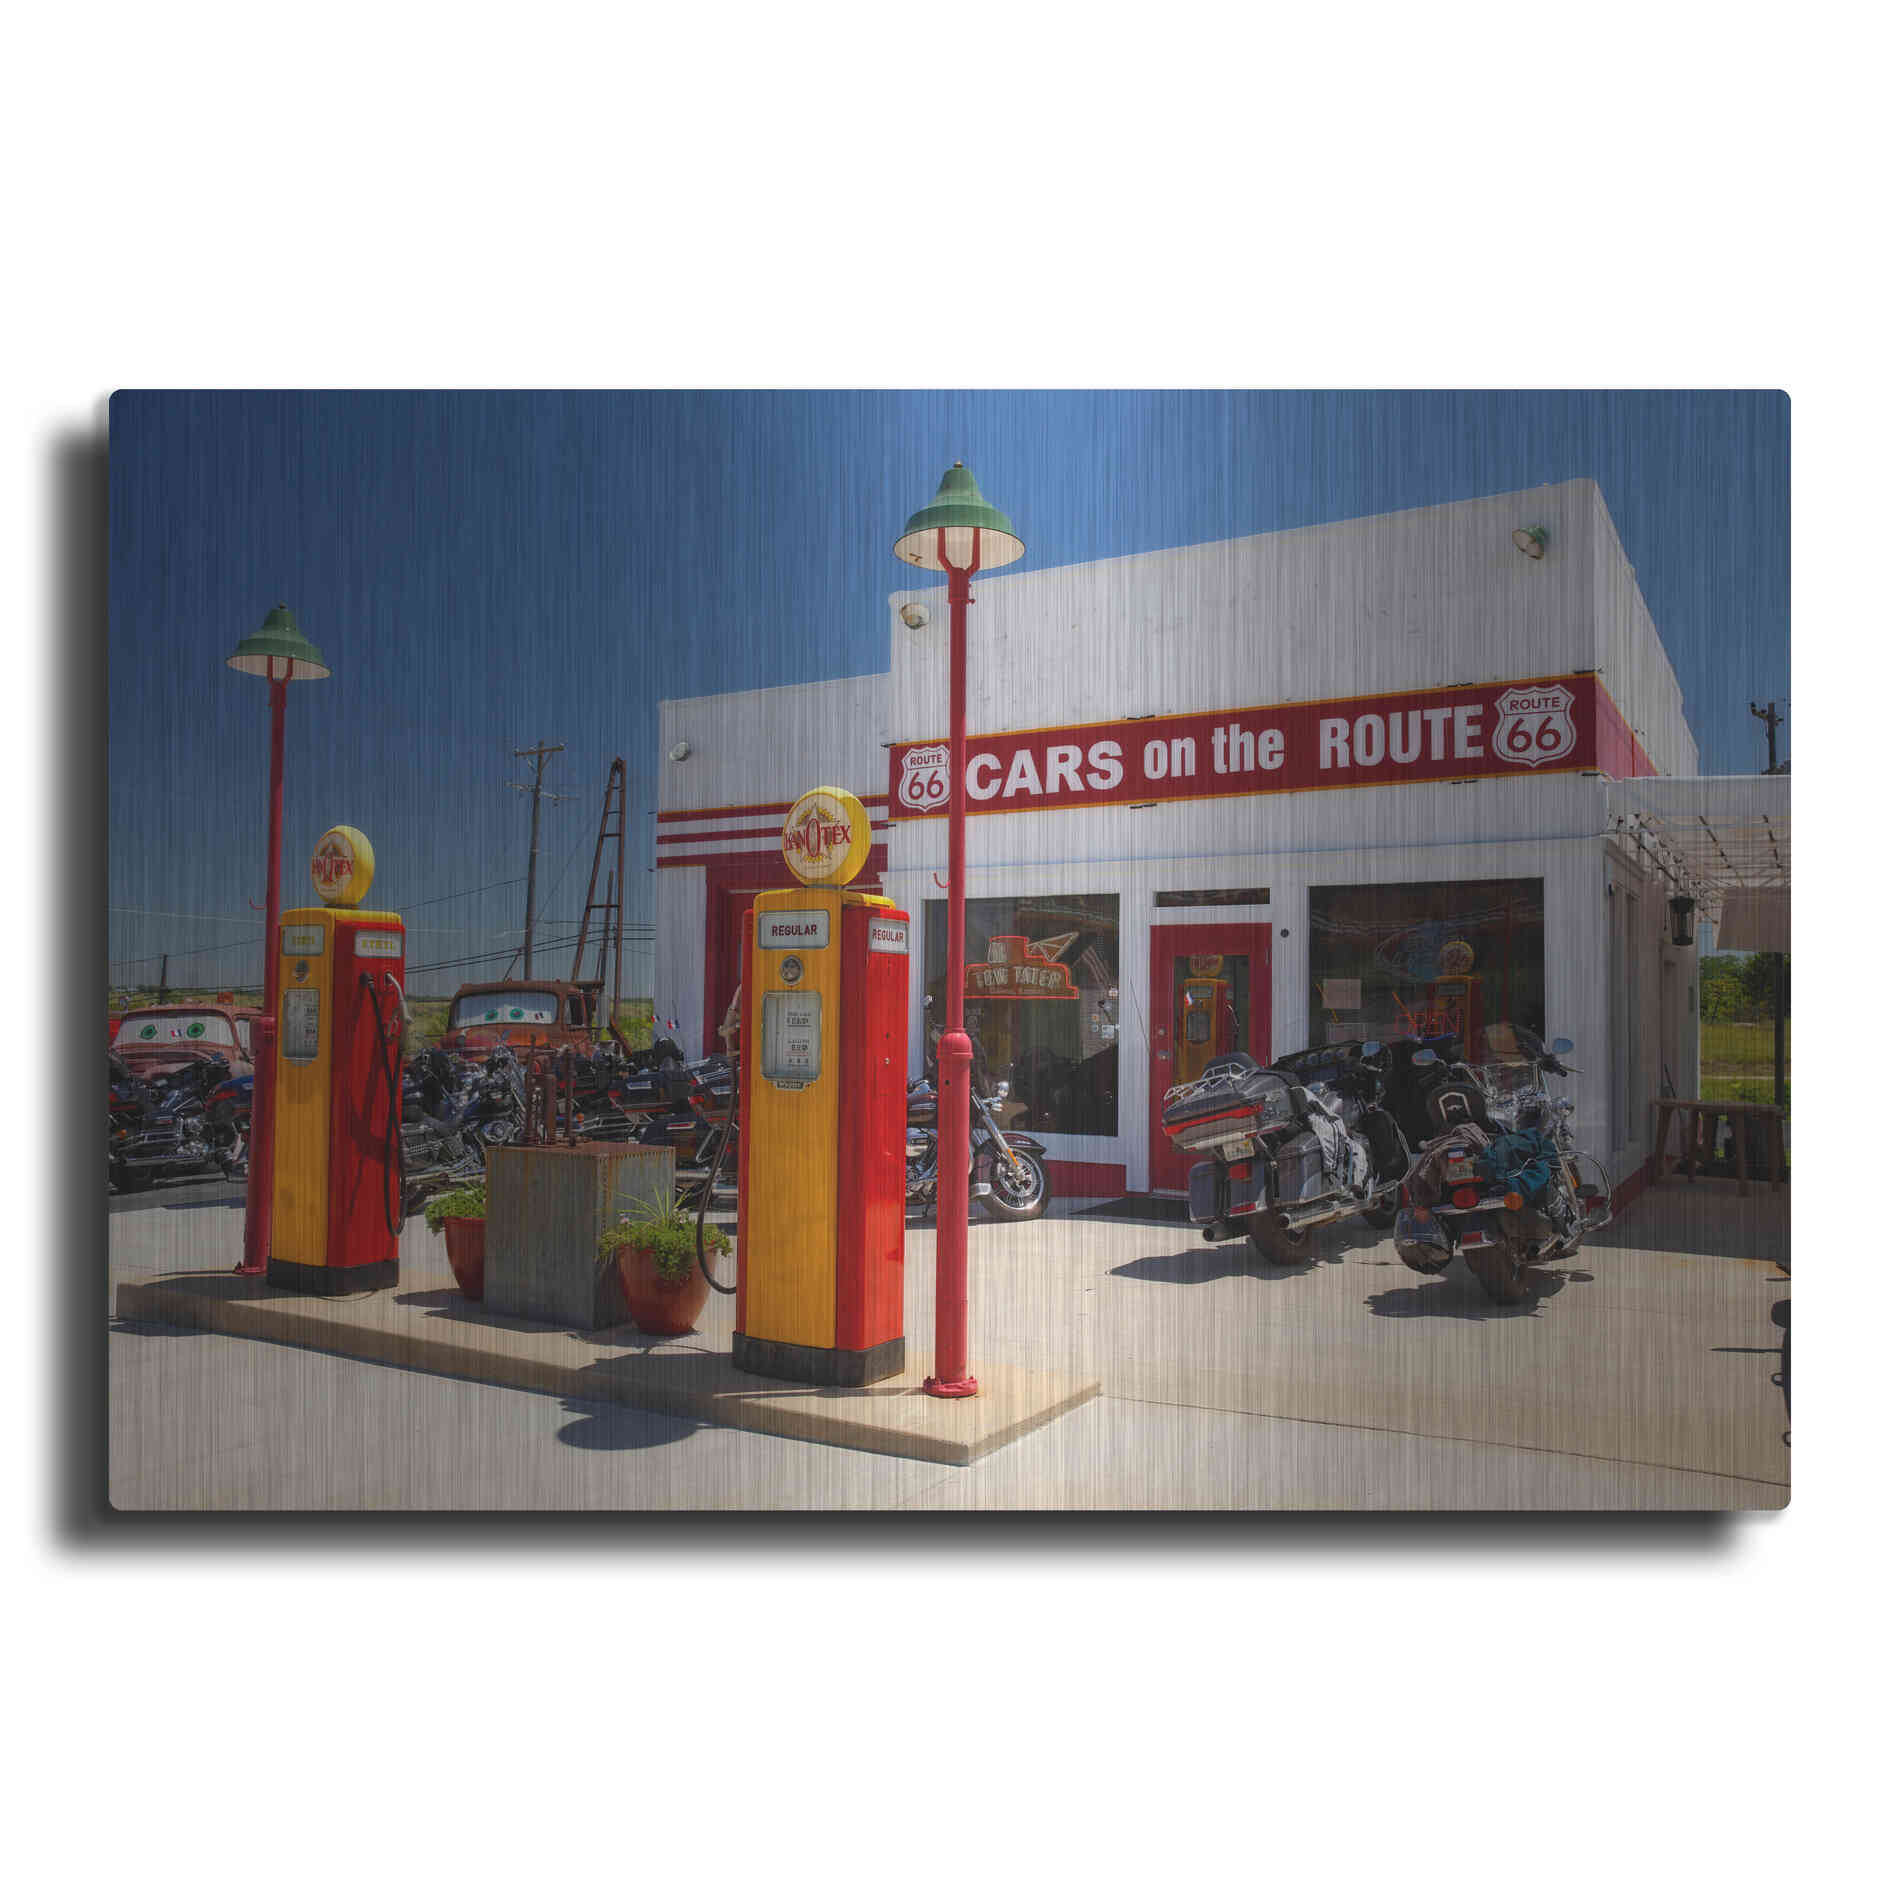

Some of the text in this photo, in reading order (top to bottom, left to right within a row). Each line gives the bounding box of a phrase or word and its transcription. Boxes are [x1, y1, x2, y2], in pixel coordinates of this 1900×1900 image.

[1509, 696, 1561, 712] ROUTE
[1507, 716, 1561, 753] 66
[909, 753, 943, 766] ROUTE
[966, 703, 1484, 801] CARS on the ROUTE
[908, 769, 944, 800] 66
[771, 924, 818, 937] REGULAR
[872, 928, 905, 943] REGULAR
